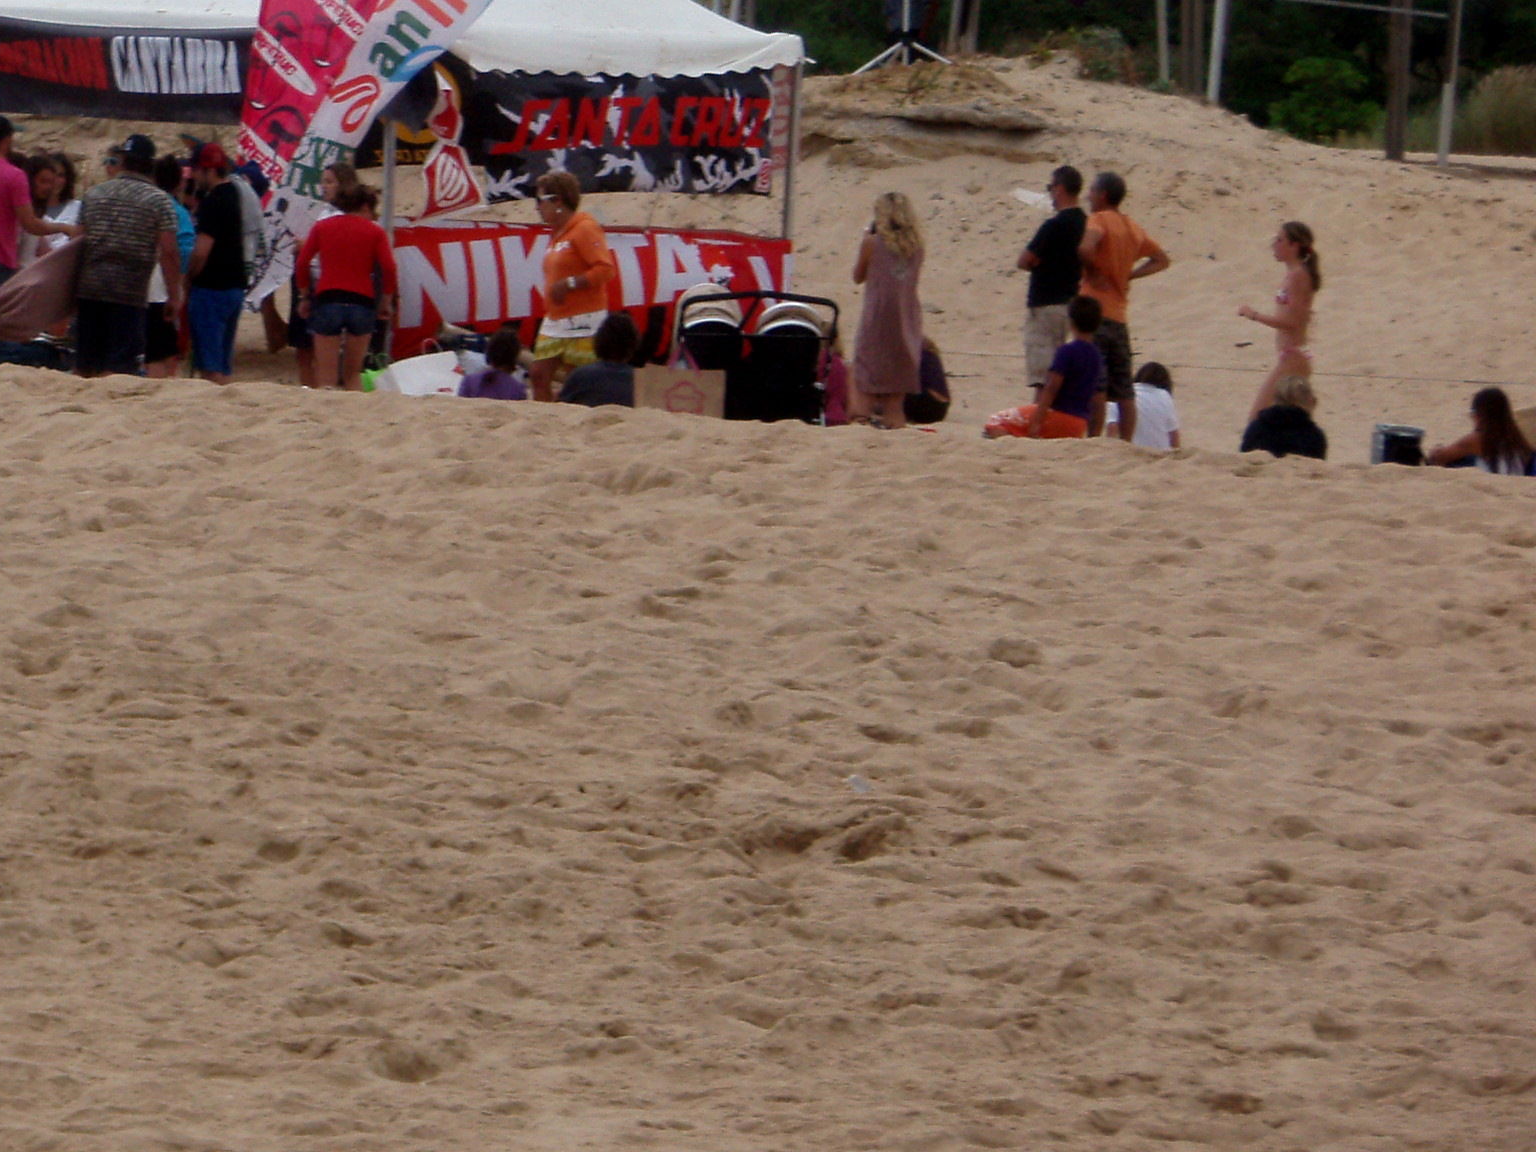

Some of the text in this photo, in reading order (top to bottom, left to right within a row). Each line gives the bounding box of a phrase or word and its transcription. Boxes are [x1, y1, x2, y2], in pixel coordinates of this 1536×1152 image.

[110, 35, 243, 95] CANTABRA
[490, 95, 662, 155] SANTA
[670, 96, 772, 149] CRUZ
[394, 232, 707, 330] NIKTA
